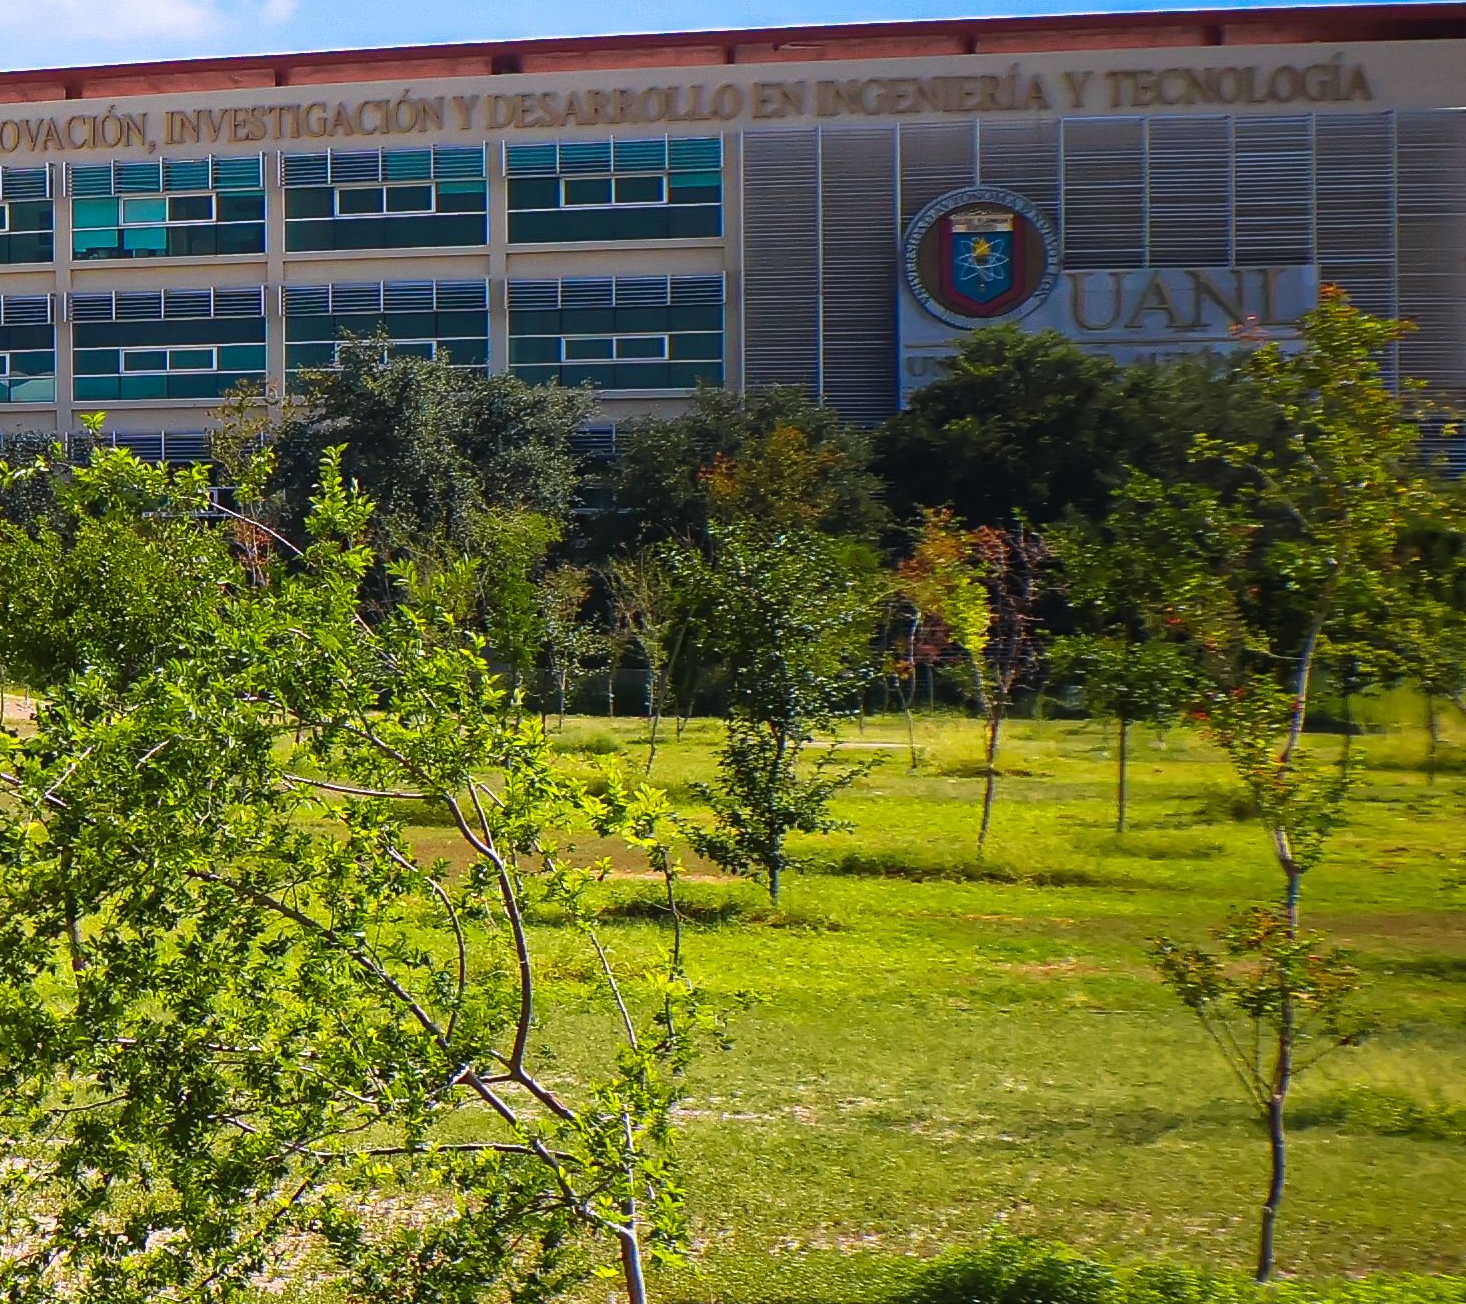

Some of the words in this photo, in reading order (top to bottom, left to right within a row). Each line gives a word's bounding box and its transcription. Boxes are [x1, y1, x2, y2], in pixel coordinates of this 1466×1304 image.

[164, 88, 444, 145] INVESTIGACIÓN
[451, 94, 479, 130] Y
[486, 83, 744, 130] DESARROLLO
[753, 79, 807, 119] EN
[816, 62, 1054, 115] INGENIERÍA
[1062, 70, 1093, 108] Y
[1104, 51, 1373, 107] TECNOLOGÍA
[1068, 267, 1303, 331] UANL
